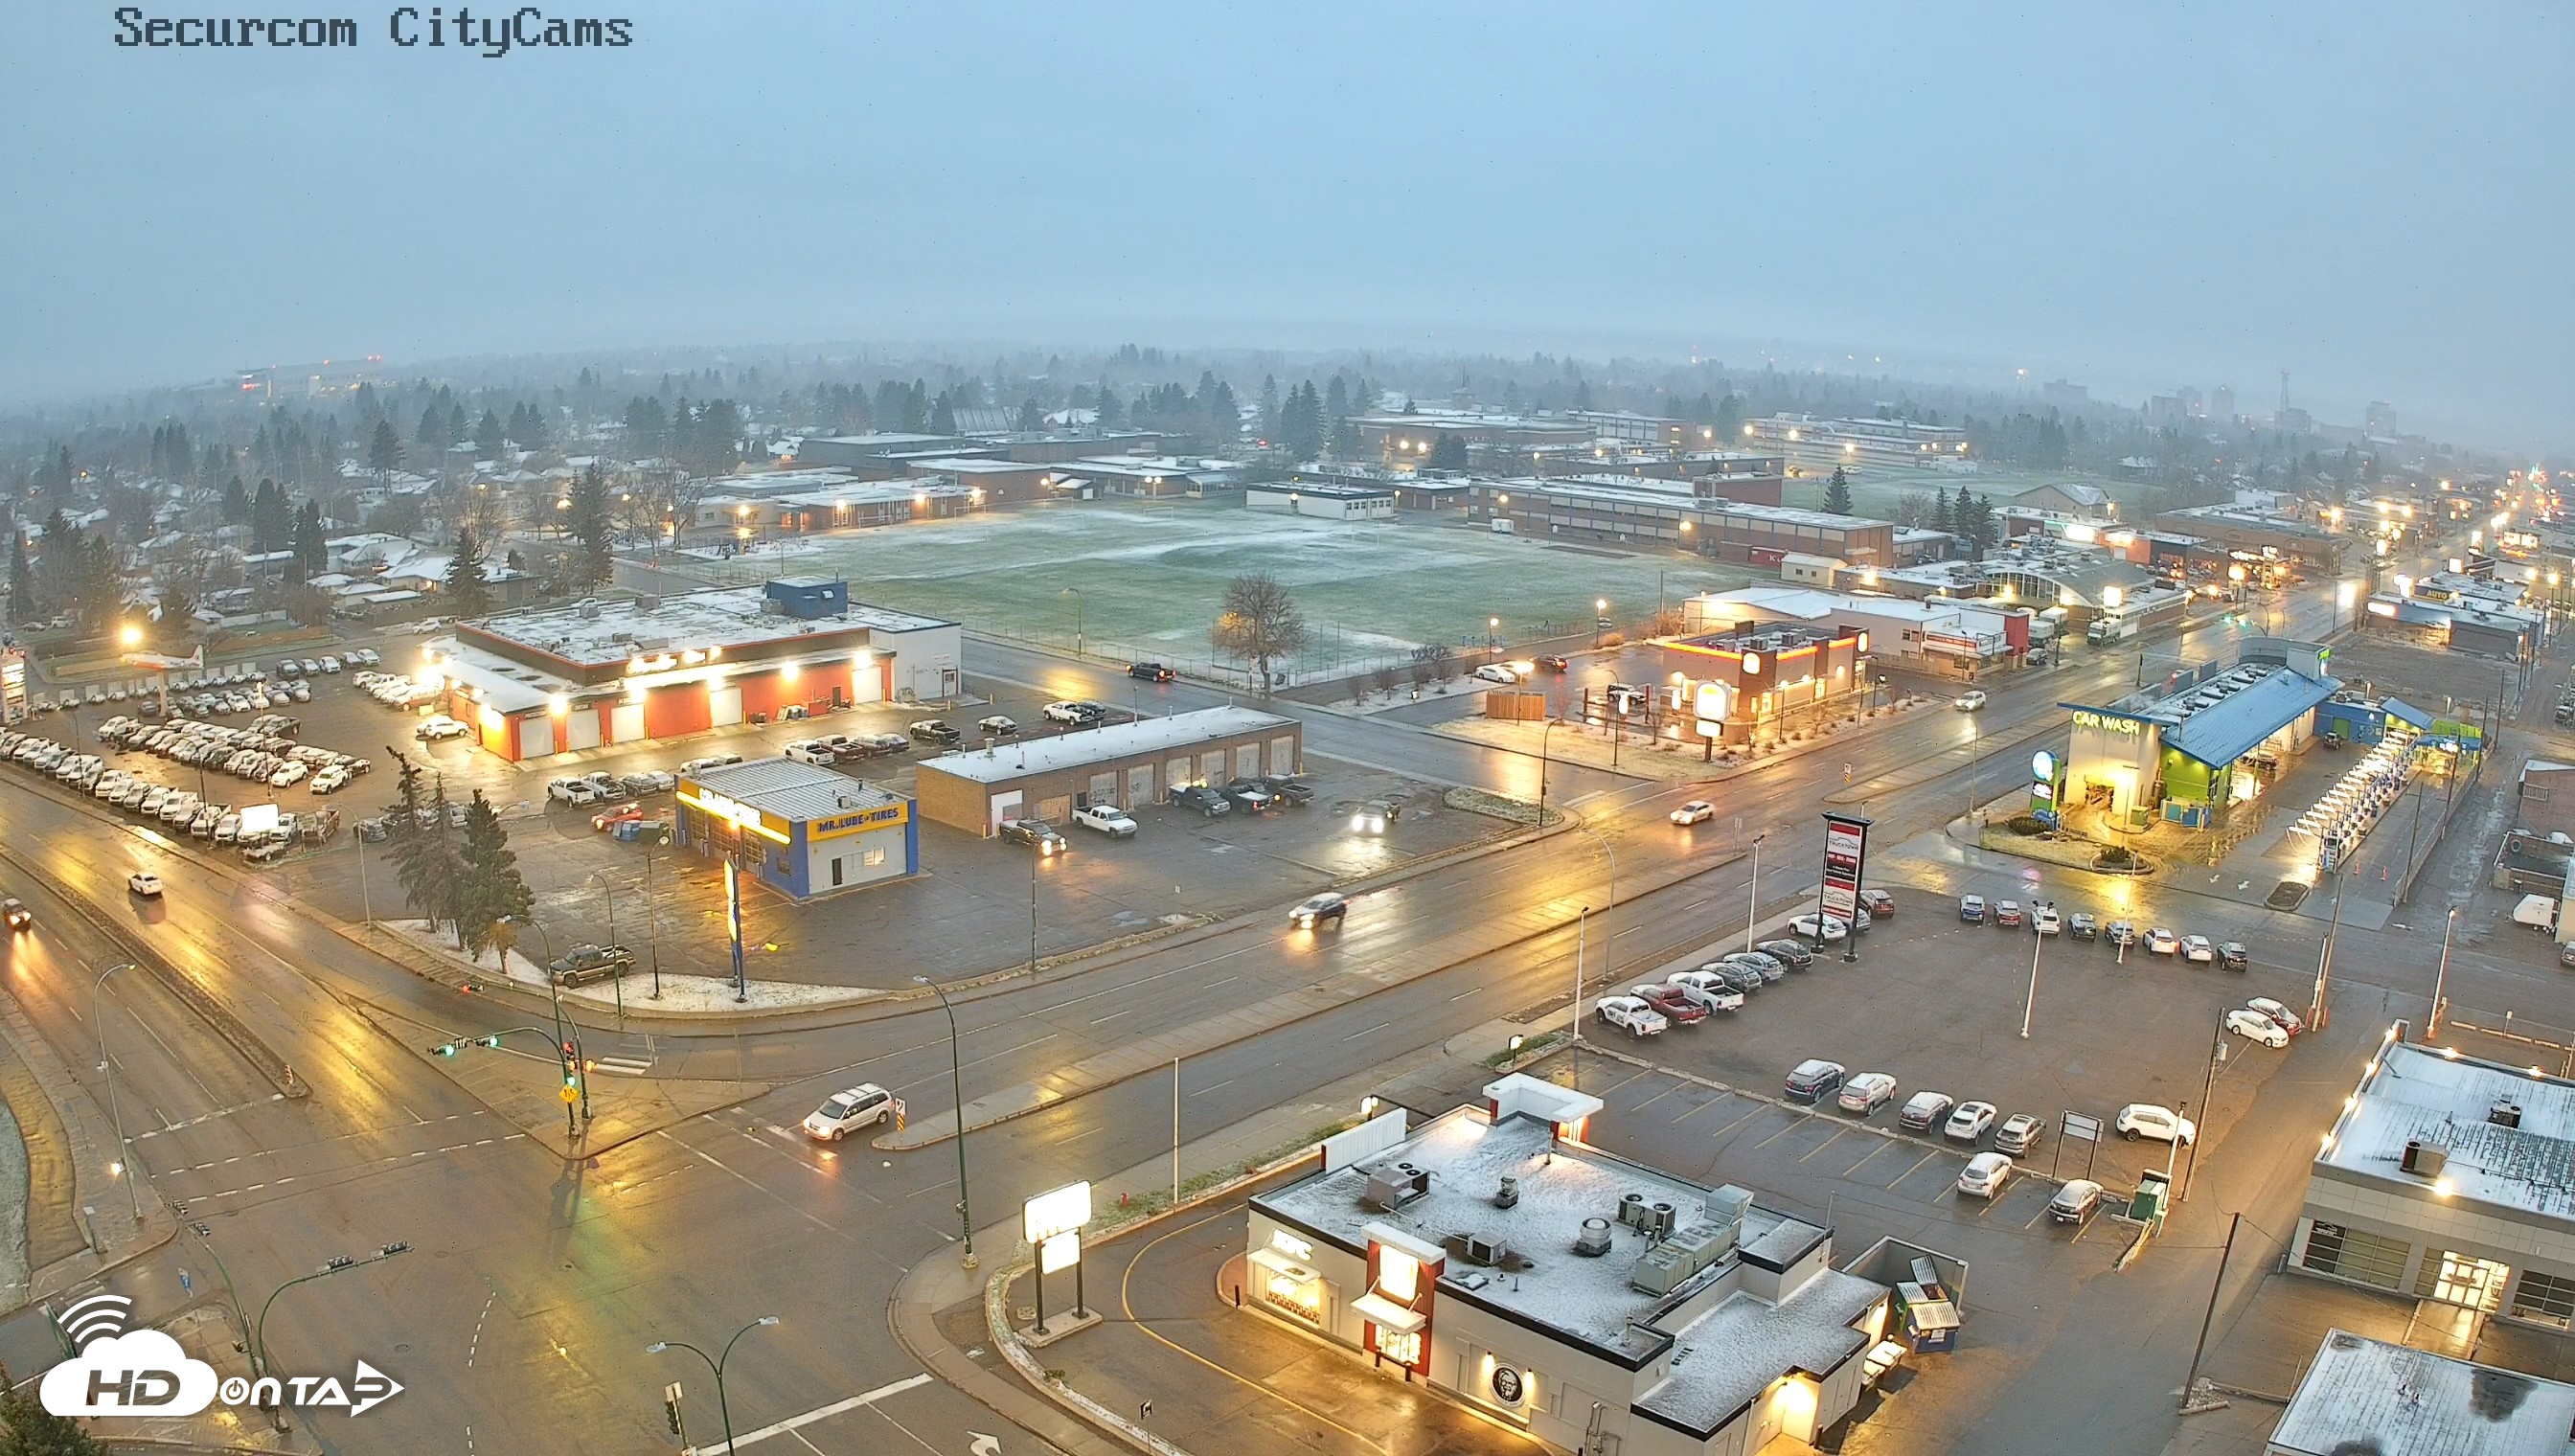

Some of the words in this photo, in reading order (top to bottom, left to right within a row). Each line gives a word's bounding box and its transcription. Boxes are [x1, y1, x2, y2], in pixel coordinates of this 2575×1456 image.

[2427, 590, 2448, 600] AUTO
[2072, 711, 2101, 728] CAR
[2101, 715, 2140, 736] WASH
[839, 814, 864, 829] LUBE
[870, 808, 900, 822] TIRES
